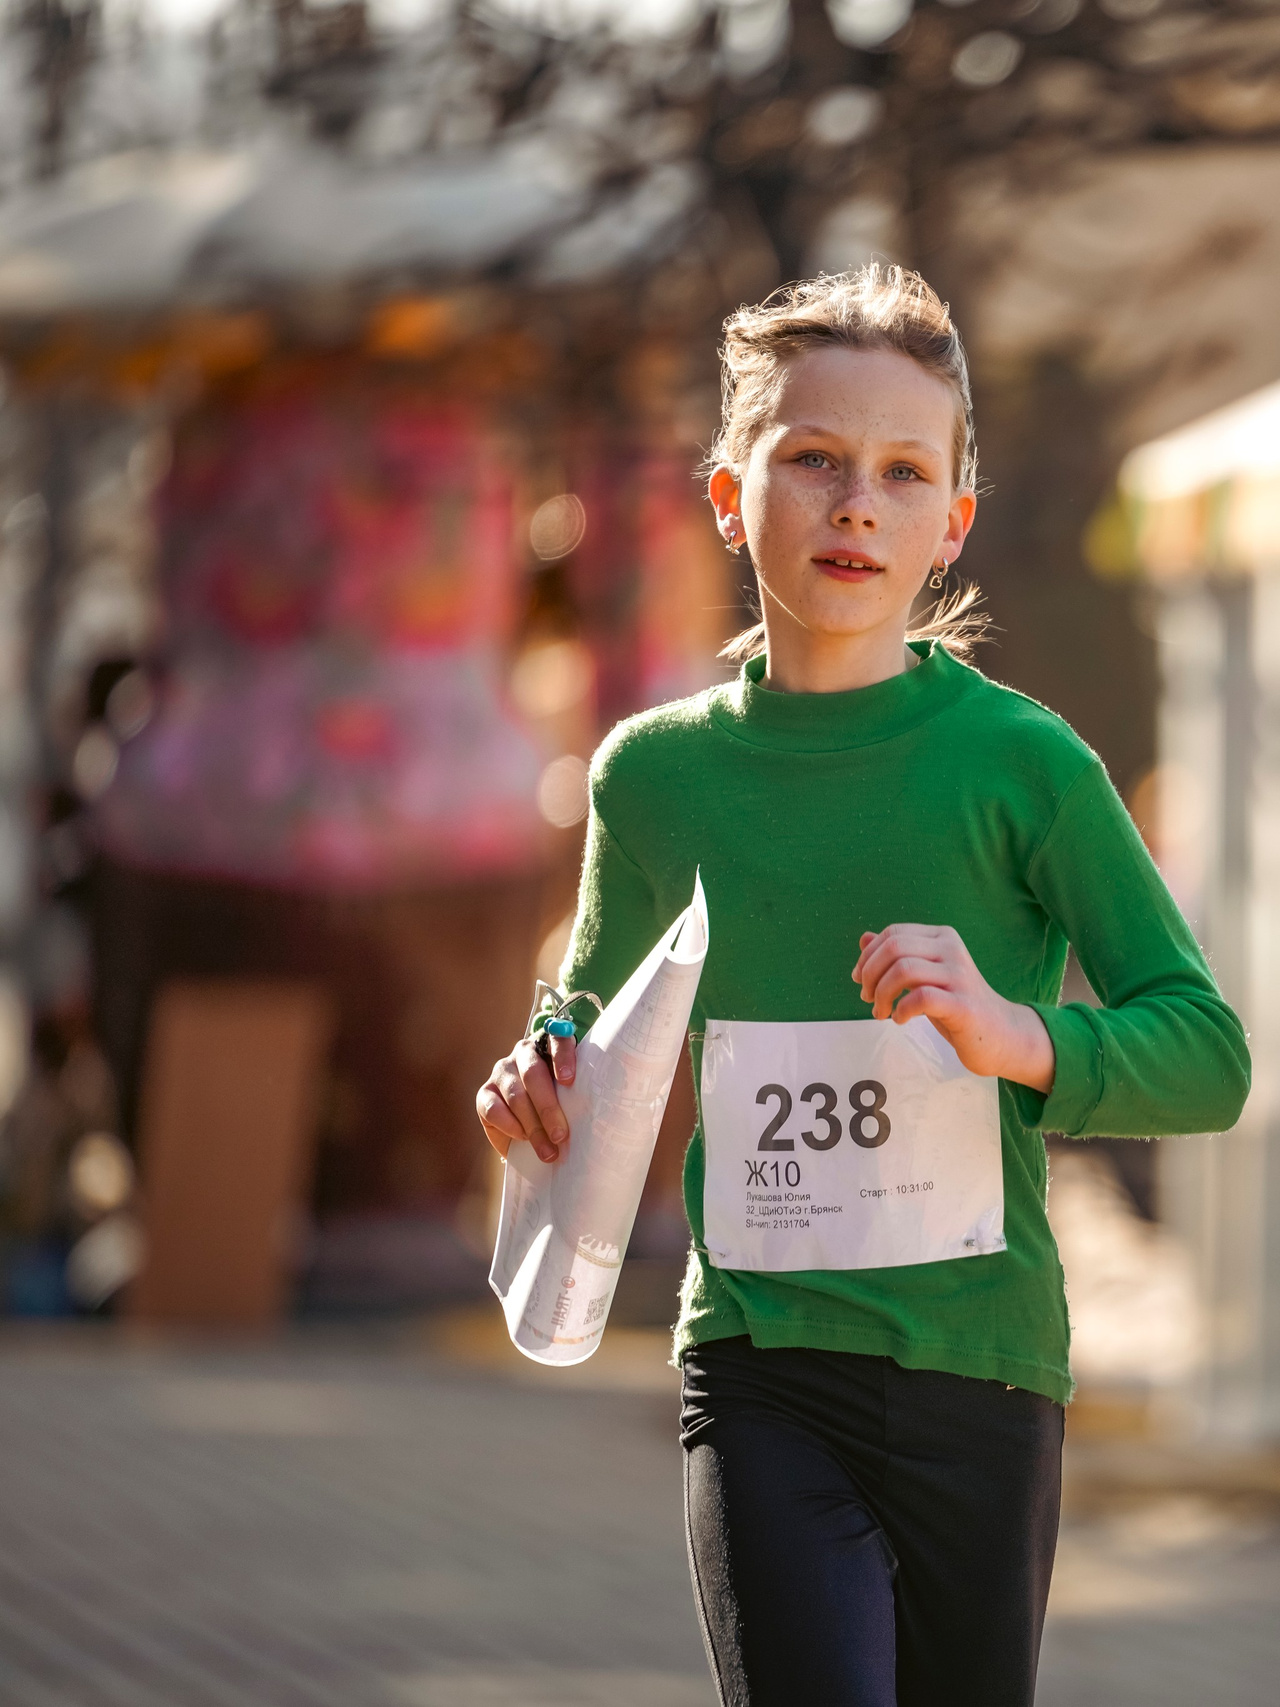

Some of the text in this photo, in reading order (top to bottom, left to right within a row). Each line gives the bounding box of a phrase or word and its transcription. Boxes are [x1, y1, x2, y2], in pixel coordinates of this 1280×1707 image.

[755, 1079, 892, 1152] 238
[744, 1159, 801, 1187] Ж10
[746, 1191, 811, 1203] Лукашова Юлия
[859, 1188, 887, 1199] Старт
[896, 1181, 934, 1194] 10:31:00
[804, 1205, 843, 1216] г.Брянск
[773, 1219, 810, 1229] 2131704
